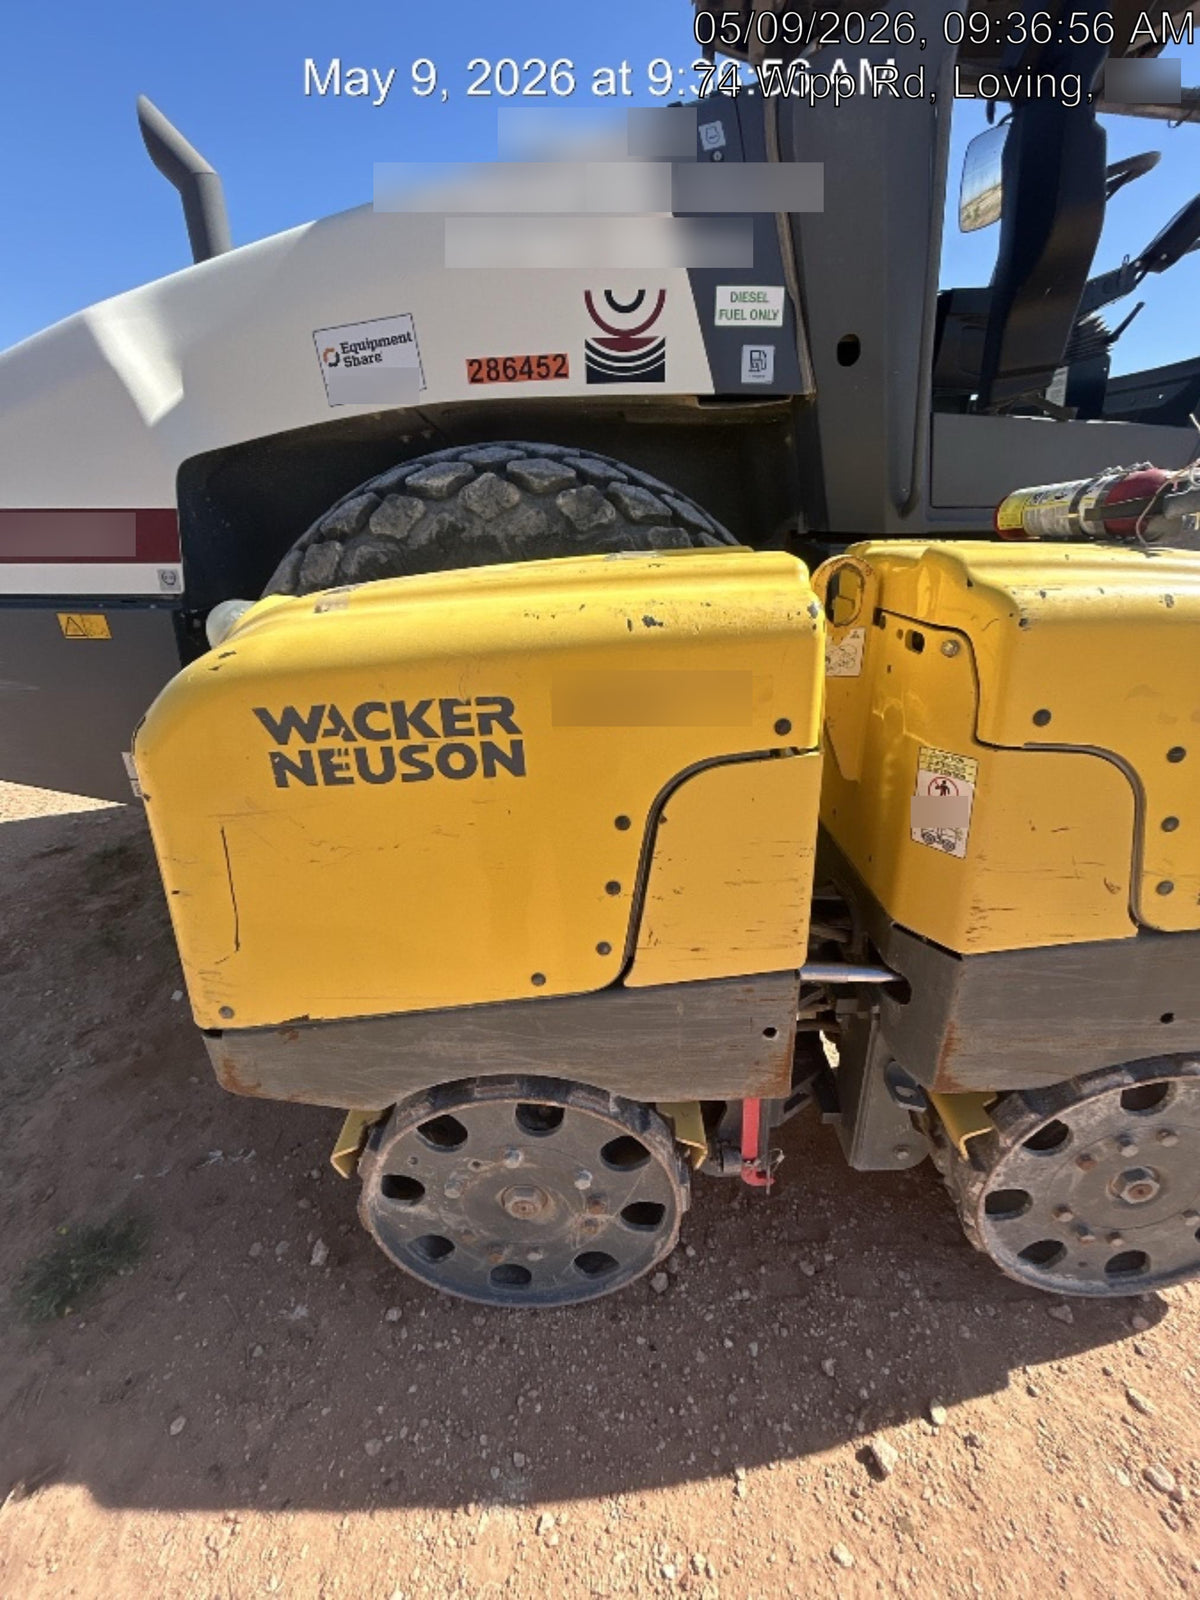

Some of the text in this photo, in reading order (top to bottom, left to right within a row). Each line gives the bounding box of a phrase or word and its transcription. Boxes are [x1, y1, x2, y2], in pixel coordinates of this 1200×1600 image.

[730, 291, 769, 303] DIESEL
[719, 308, 780, 321] FUEL ONLY
[340, 331, 413, 356] Equipment
[344, 352, 382, 369] Share
[468, 353, 568, 385] 286452
[252, 696, 523, 746] WACKER
[268, 739, 527, 788] NEUSON
